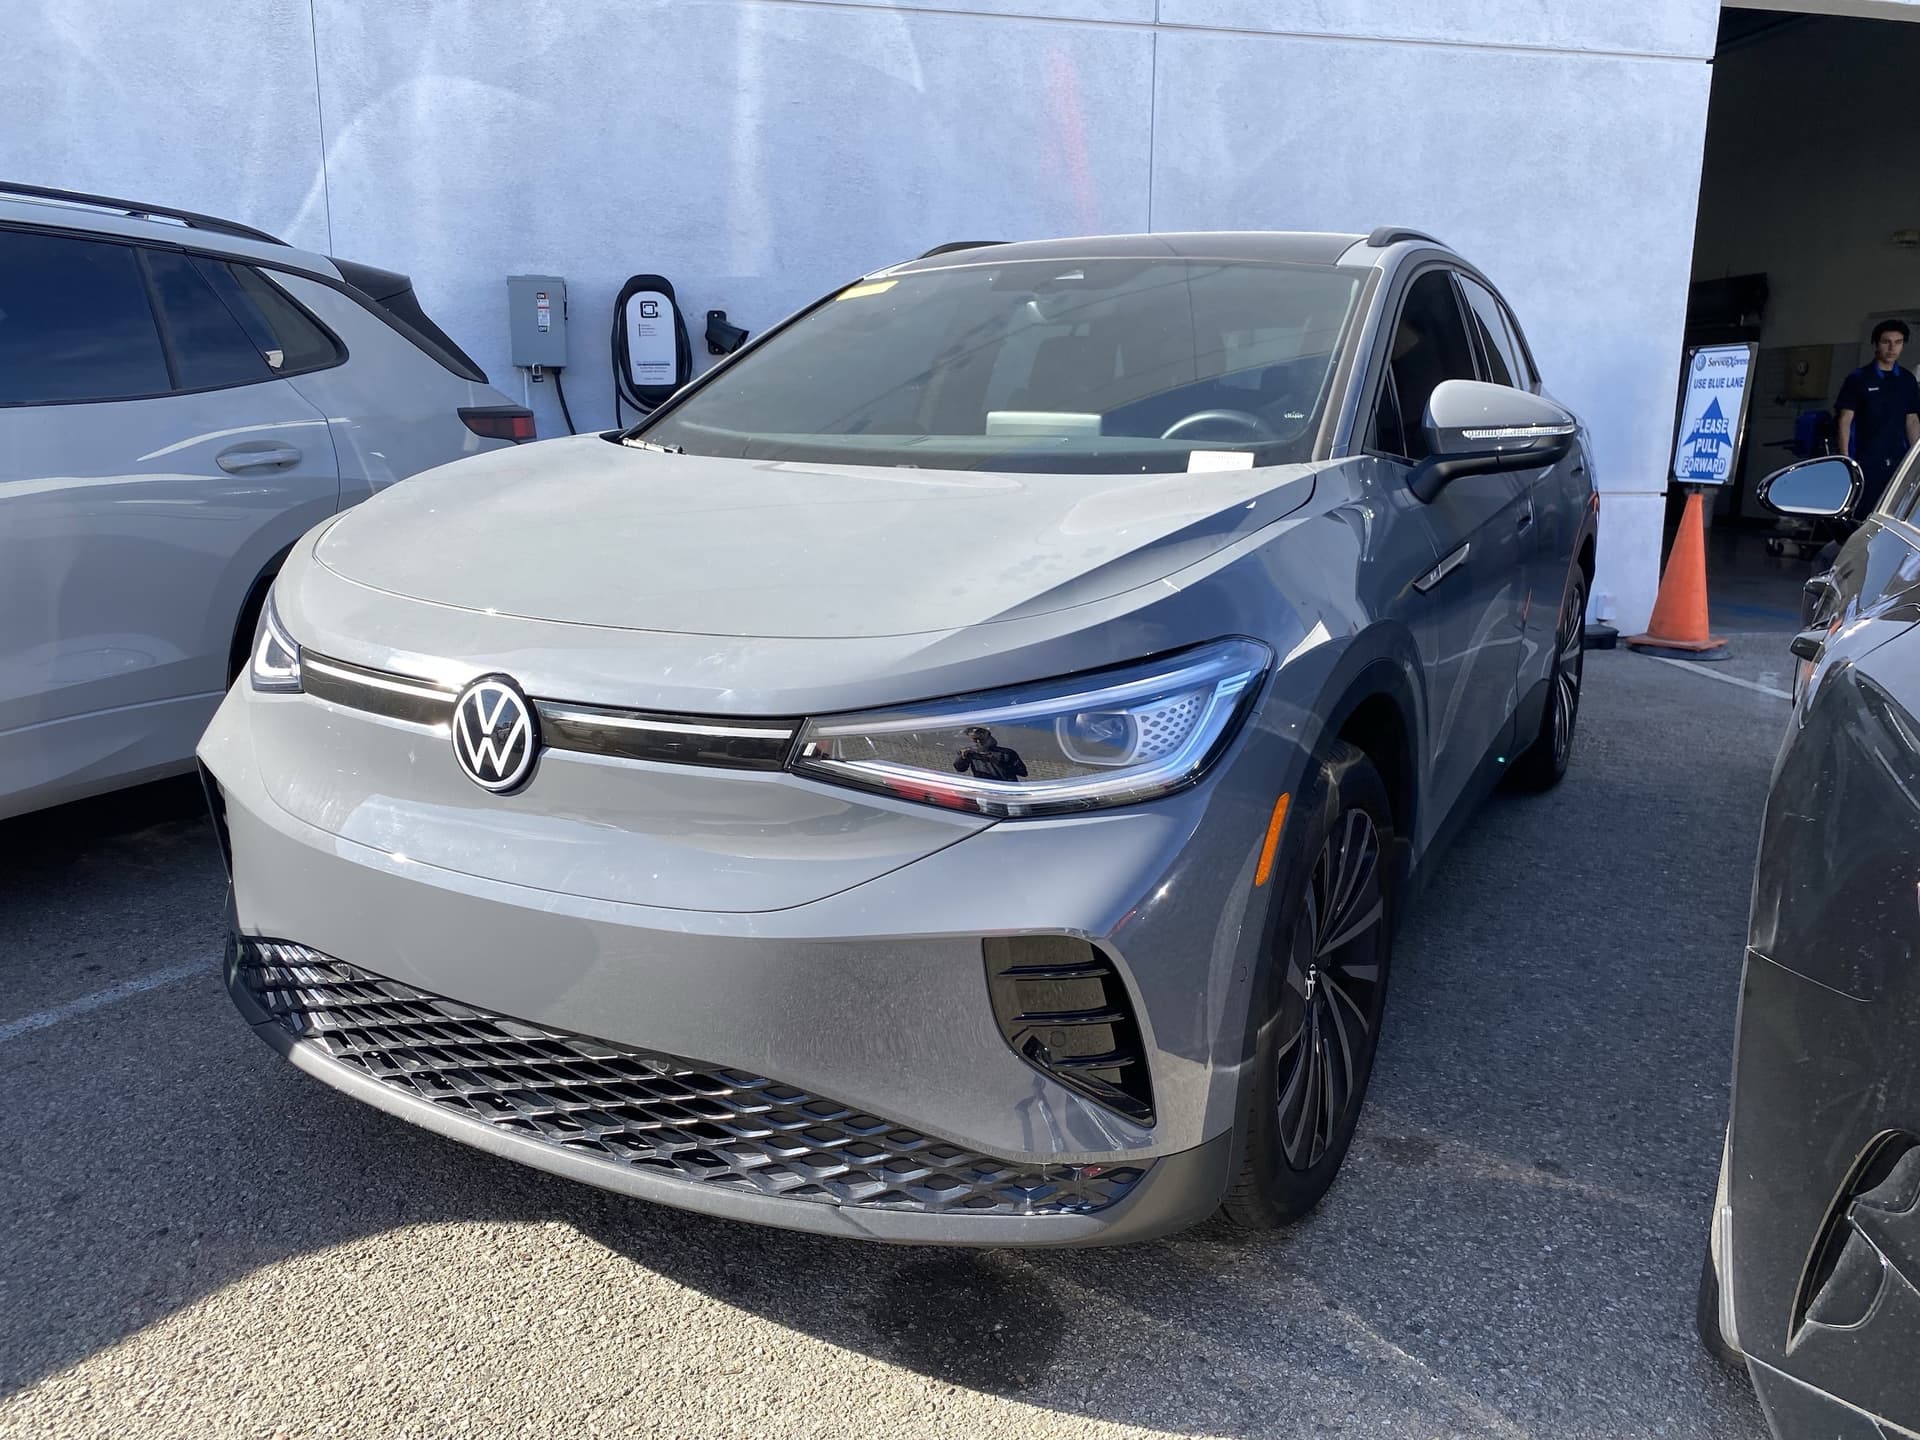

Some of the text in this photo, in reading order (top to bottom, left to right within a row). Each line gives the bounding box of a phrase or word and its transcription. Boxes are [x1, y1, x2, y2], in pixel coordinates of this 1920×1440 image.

[1694, 376, 1744, 389] USE BLUE LANE
[1694, 418, 1729, 434] PLEASE
[1695, 438, 1718, 453] PULL
[1682, 457, 1726, 474] FORWARD
